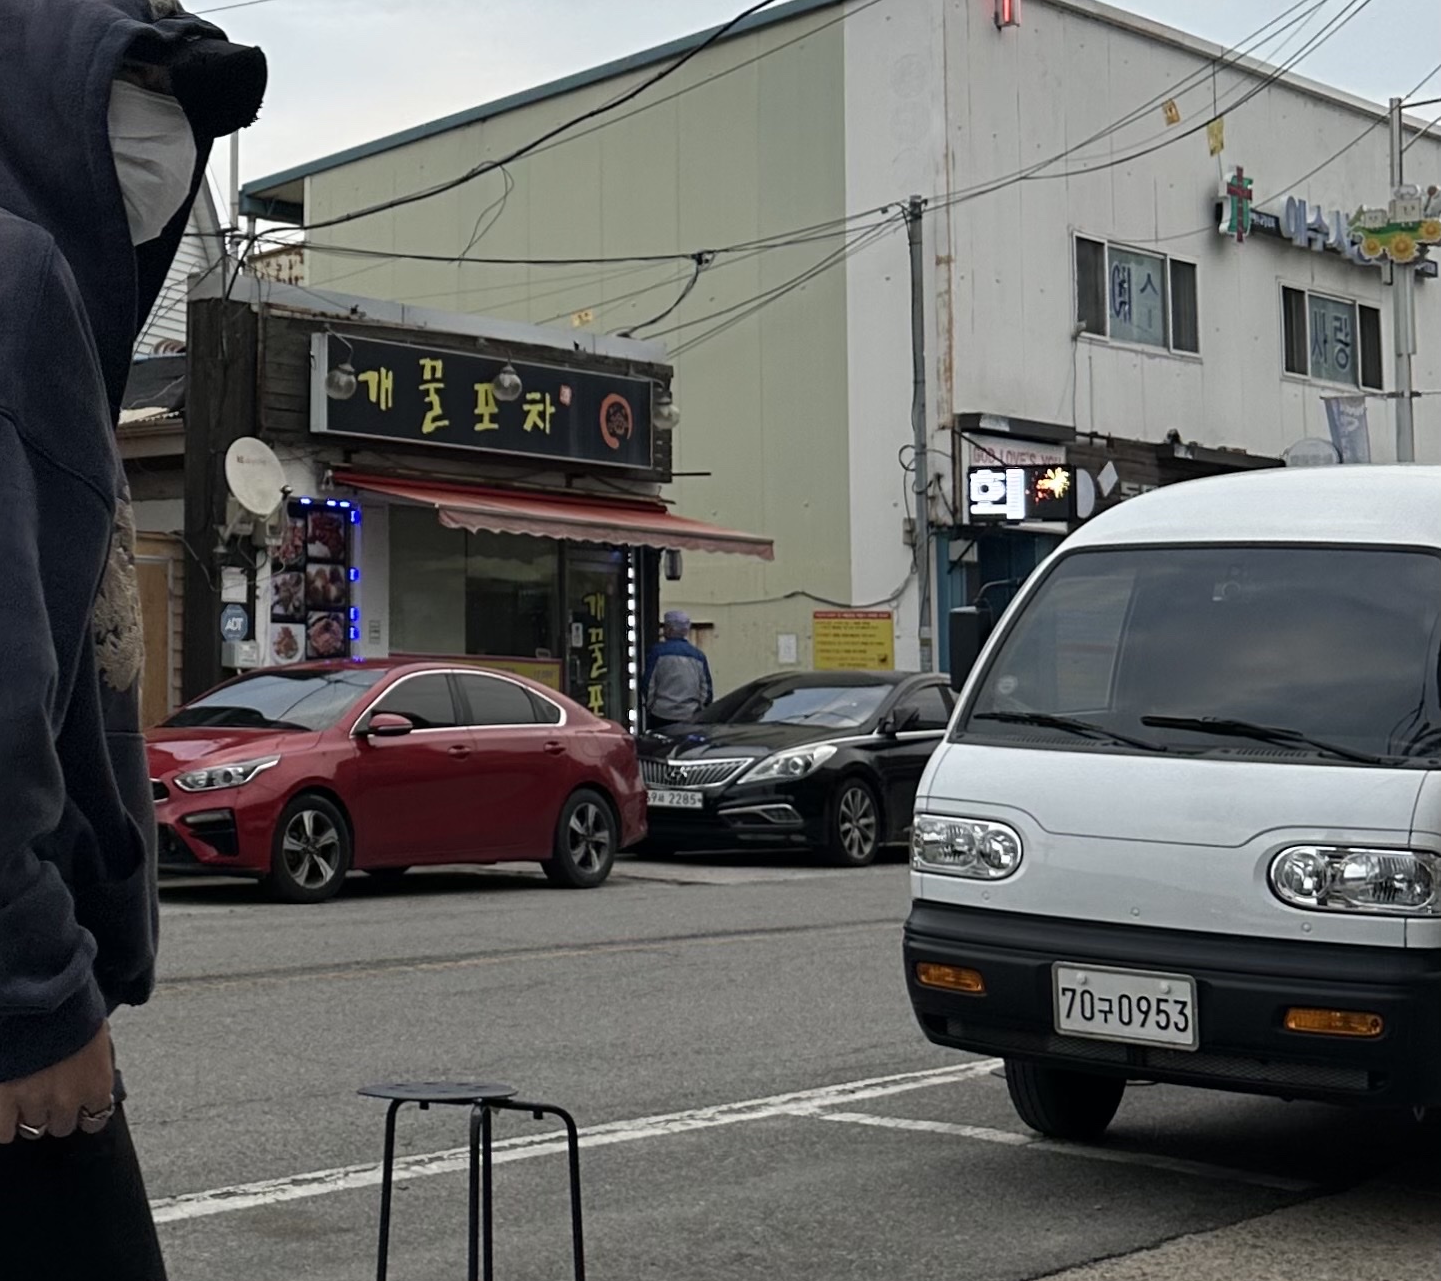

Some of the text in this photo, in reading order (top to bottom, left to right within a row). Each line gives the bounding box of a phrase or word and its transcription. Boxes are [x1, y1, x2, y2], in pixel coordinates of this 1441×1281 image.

[224, 616, 243, 631] ADT
[668, 792, 697, 806] 2285
[1061, 986, 1189, 1033] 70구0953
